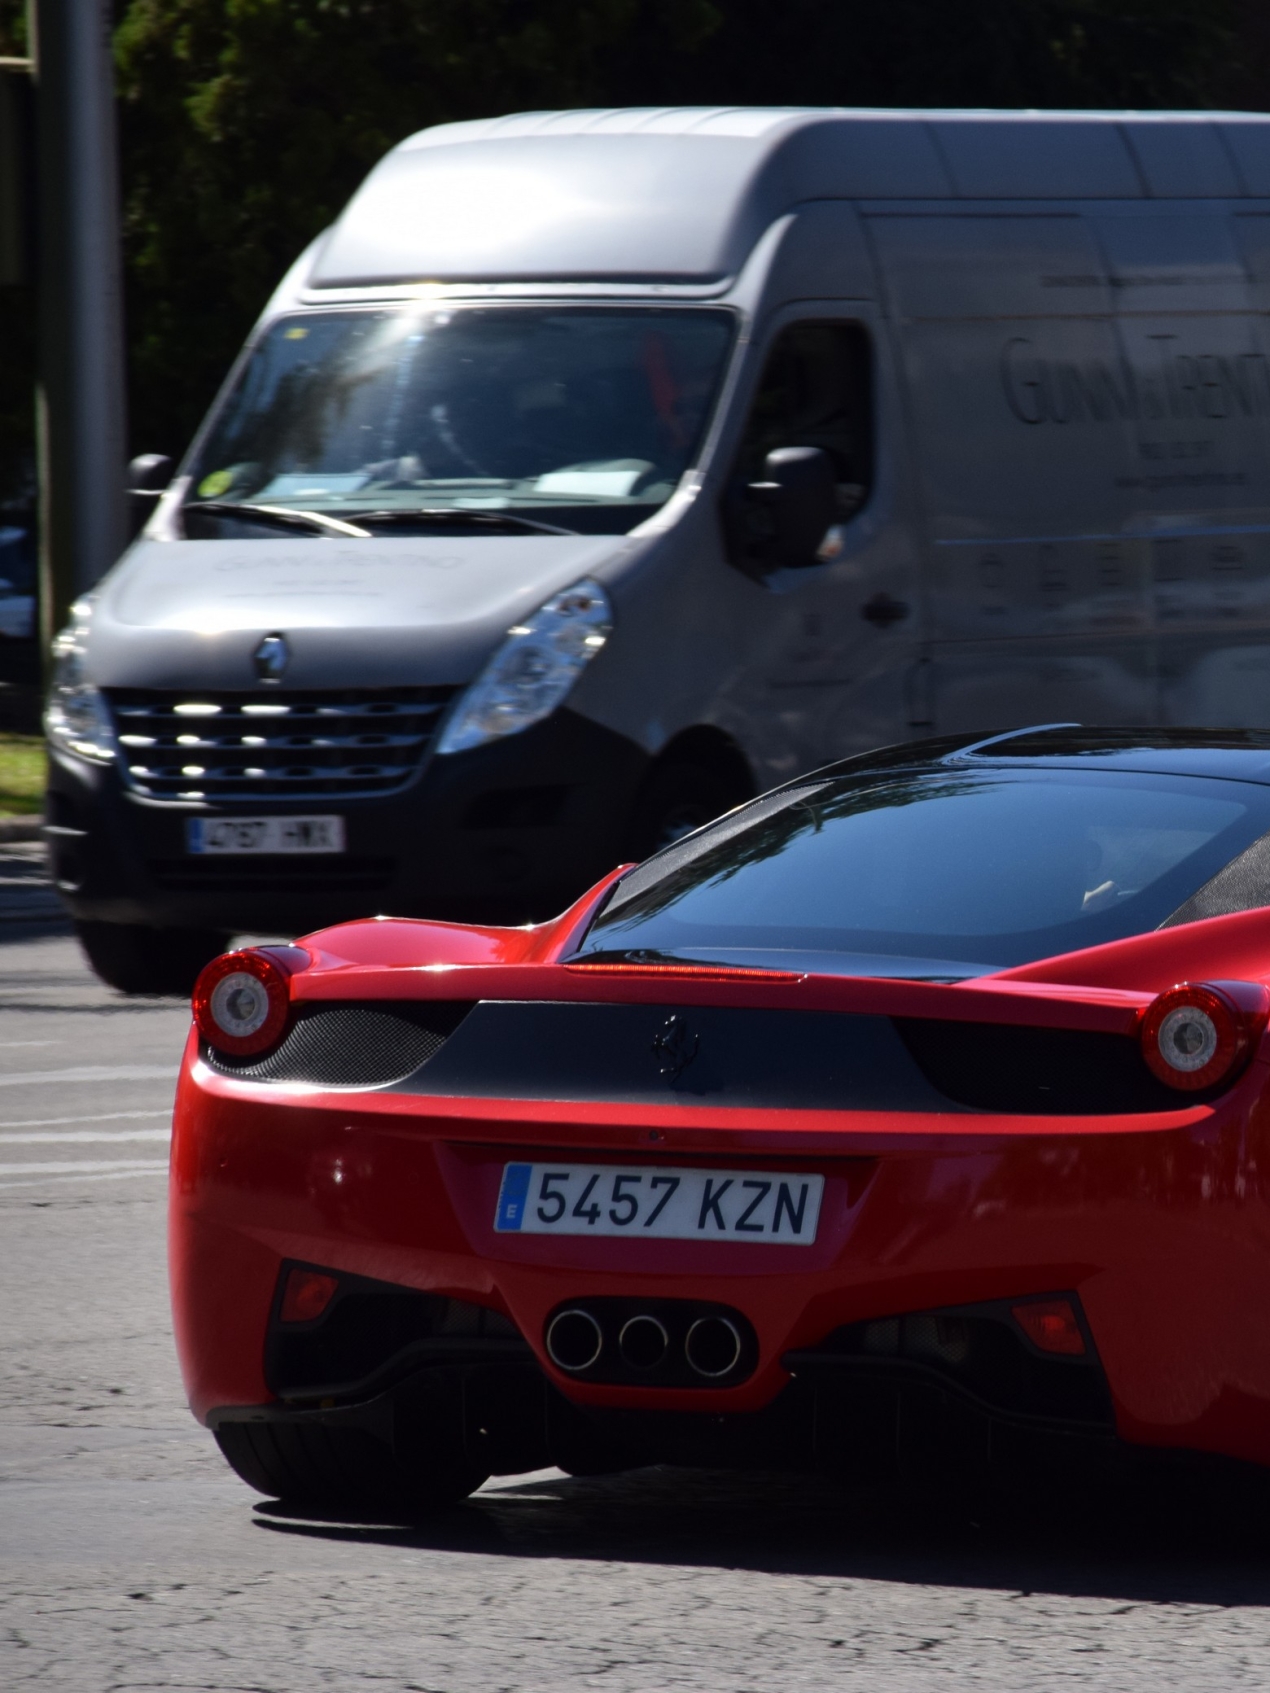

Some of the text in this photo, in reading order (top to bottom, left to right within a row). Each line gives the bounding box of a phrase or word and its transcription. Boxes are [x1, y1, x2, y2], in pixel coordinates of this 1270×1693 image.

[506, 1204, 518, 1219] E
[536, 1172, 809, 1235] 5457 KZN
